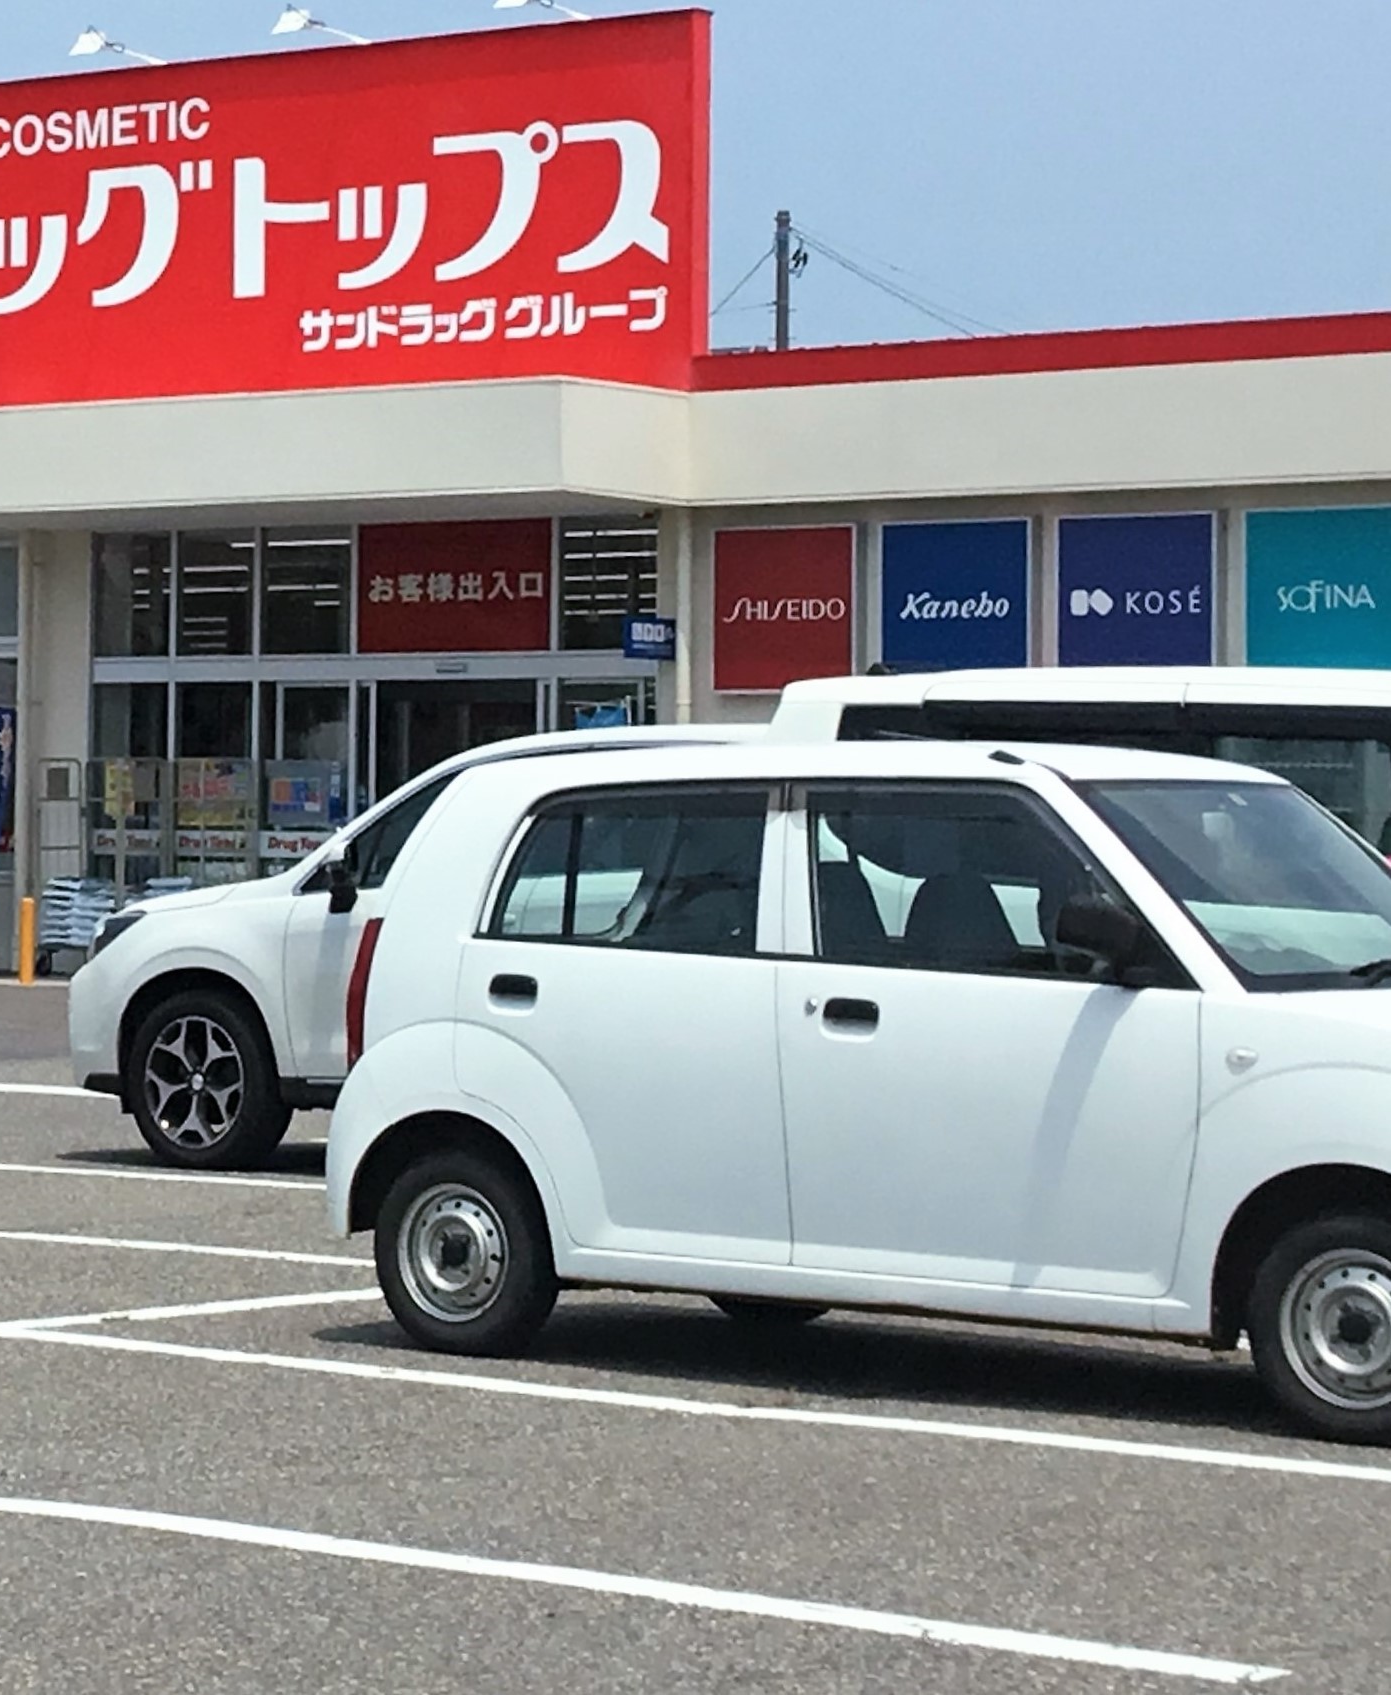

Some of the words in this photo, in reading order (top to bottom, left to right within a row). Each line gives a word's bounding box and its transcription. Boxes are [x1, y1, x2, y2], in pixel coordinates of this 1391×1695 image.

[367, 570, 545, 603] お客様出入口
[1125, 585, 1203, 615] KOSÉ
[1276, 579, 1377, 613] SOFINA
[723, 597, 846, 623] SHISEIDO
[899, 590, 1011, 620] Kanebo
